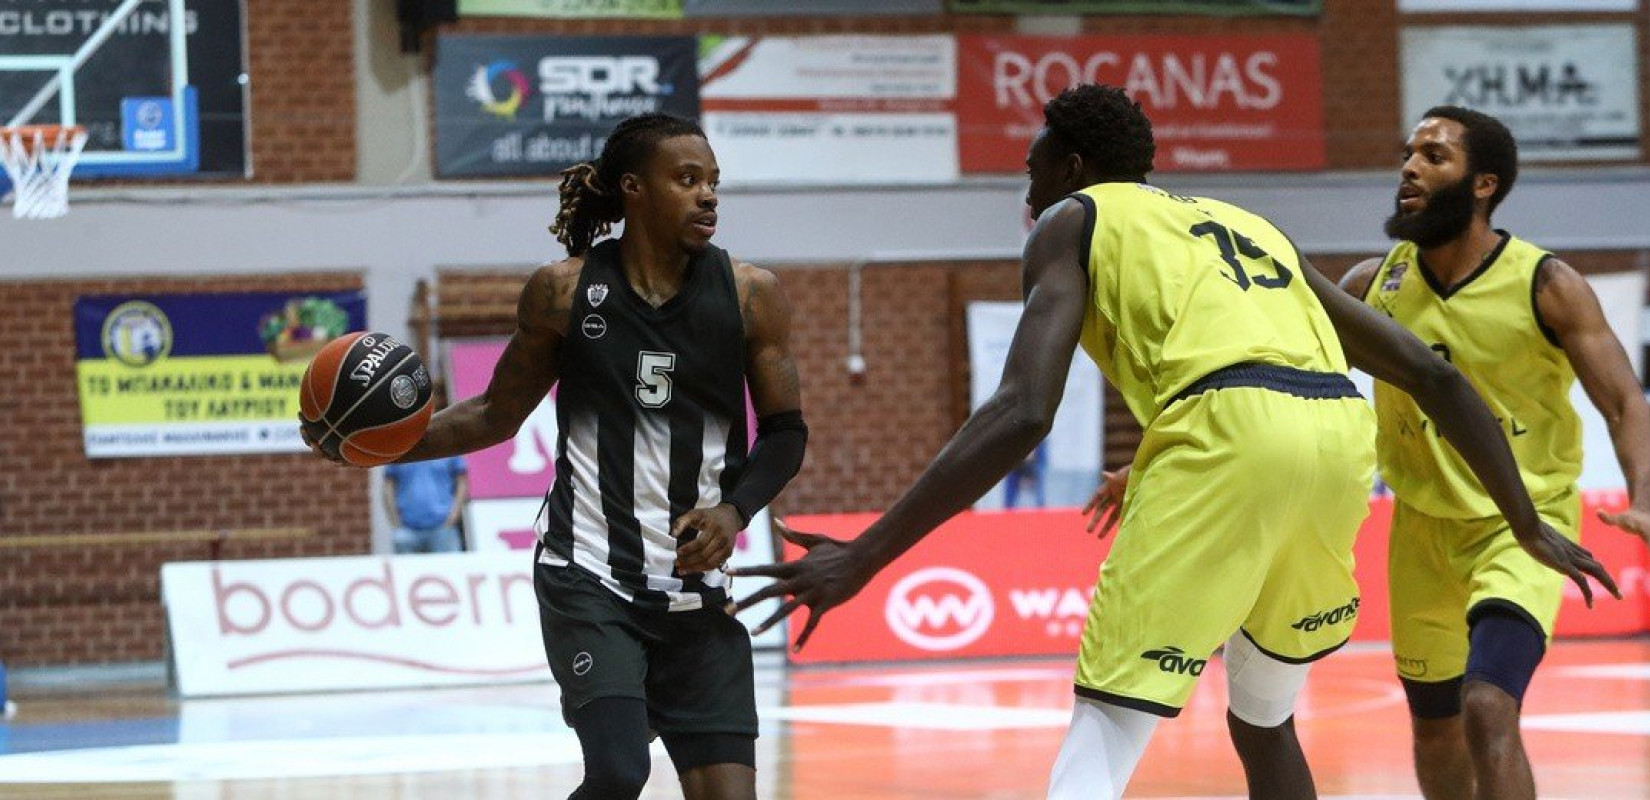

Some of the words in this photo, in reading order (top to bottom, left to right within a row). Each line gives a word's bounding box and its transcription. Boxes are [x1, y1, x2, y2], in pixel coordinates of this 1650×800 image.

[994, 51, 1284, 109] ROCANAS
[635, 351, 676, 409] 5
[1008, 587, 1097, 619] WA
